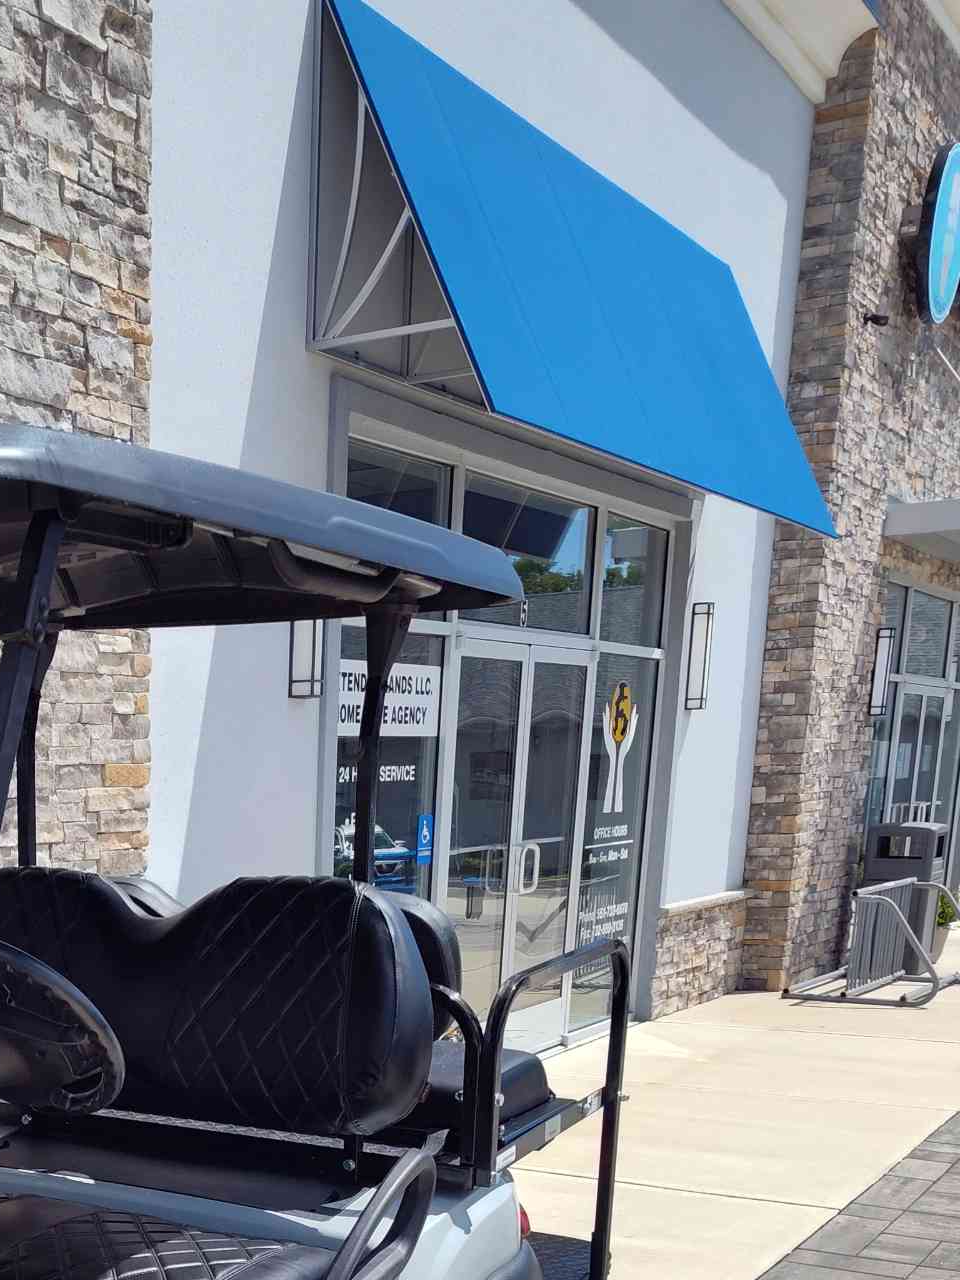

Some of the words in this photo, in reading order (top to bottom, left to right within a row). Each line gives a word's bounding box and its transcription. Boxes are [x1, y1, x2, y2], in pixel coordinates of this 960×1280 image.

[415, 677, 433, 696] LLC.
[339, 703, 361, 724] OME
[390, 705, 428, 725] AGENCY
[338, 766, 350, 783] 24
[379, 765, 416, 782] SERVICE
